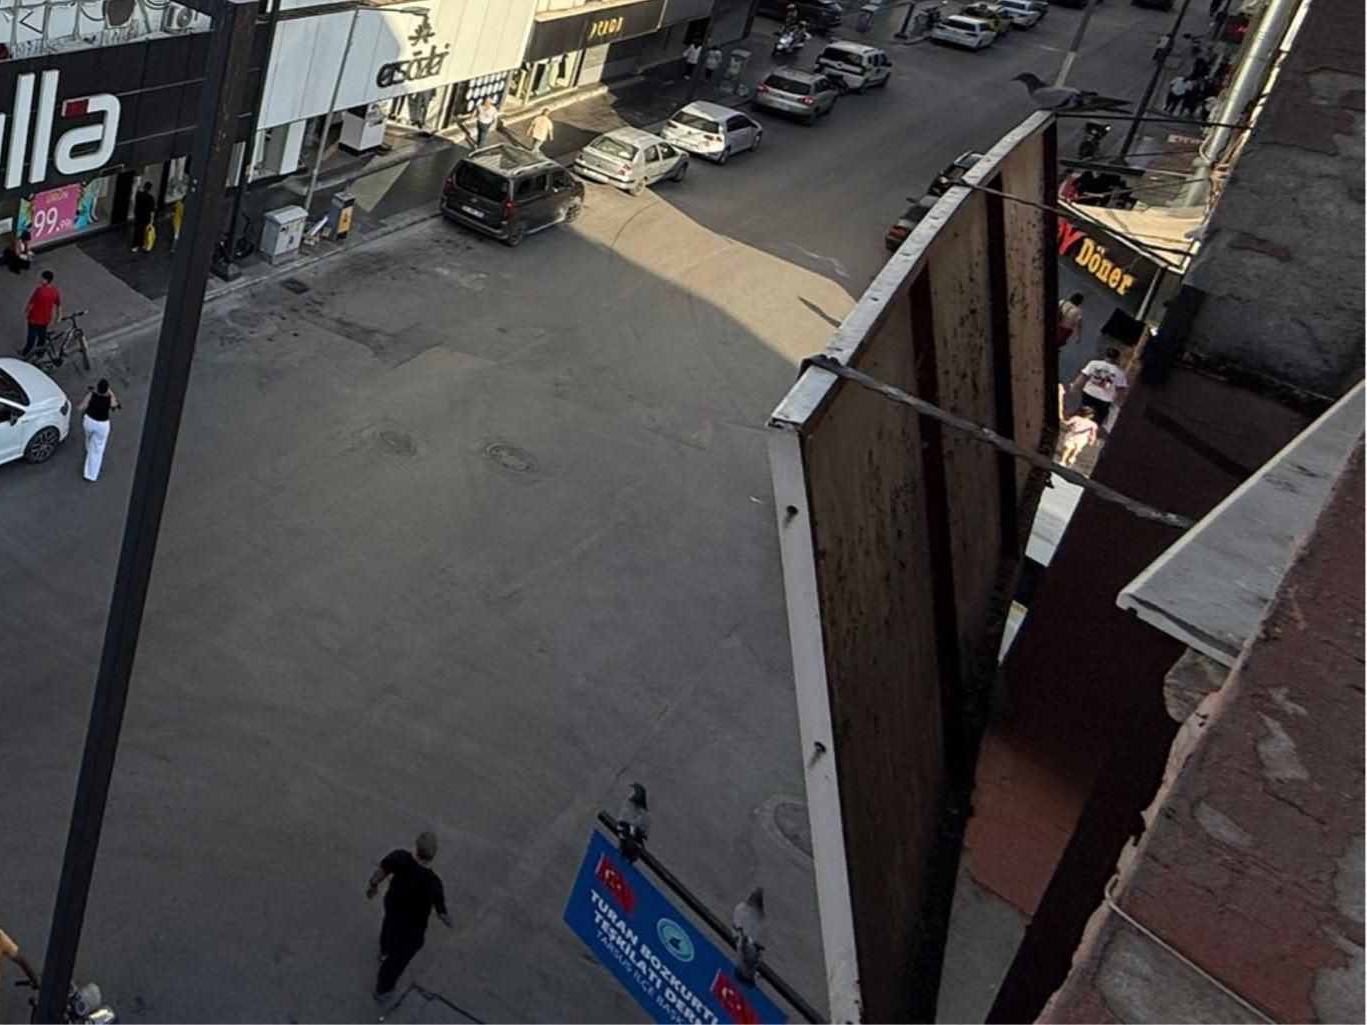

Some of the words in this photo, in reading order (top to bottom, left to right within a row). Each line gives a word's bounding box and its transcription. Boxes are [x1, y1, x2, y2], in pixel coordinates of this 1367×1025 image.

[1075, 238, 1135, 296] Döner
[591, 888, 639, 946] TURAN
[596, 929, 633, 973] TARSUS
